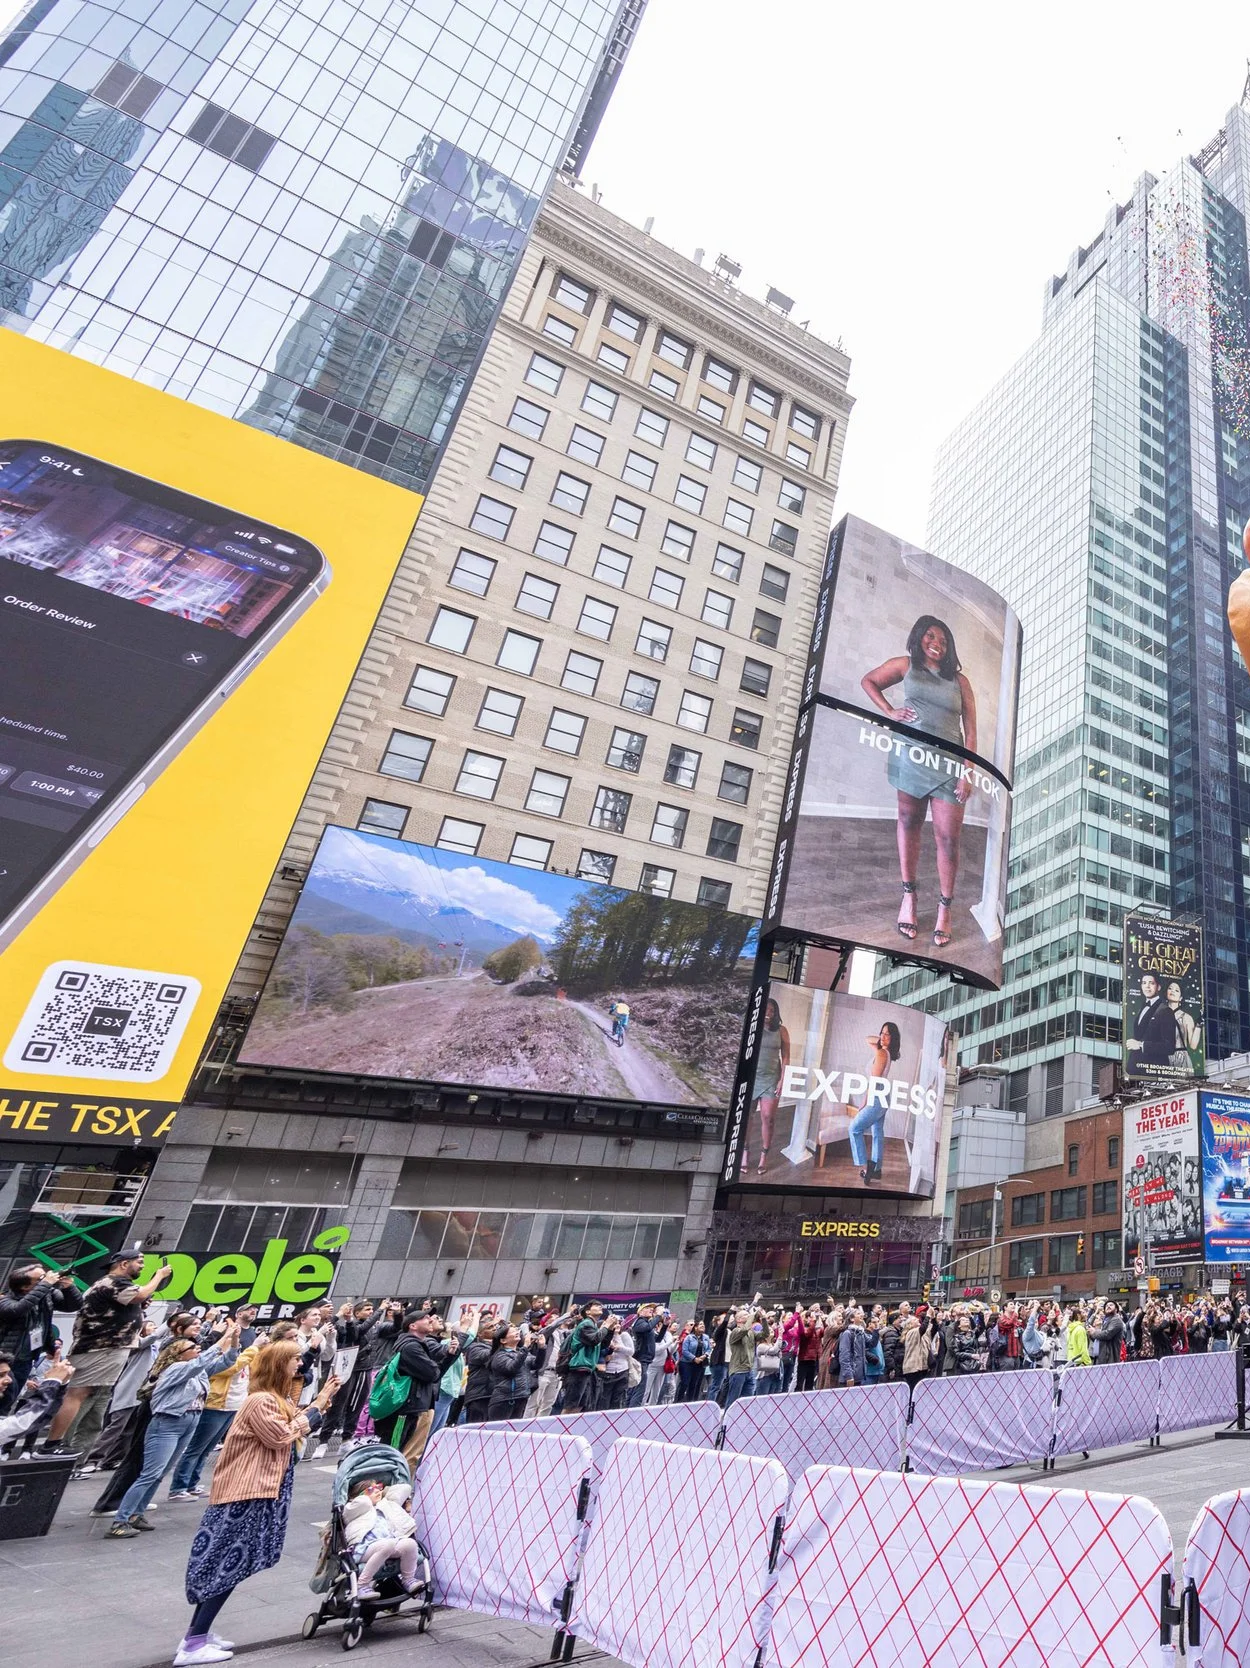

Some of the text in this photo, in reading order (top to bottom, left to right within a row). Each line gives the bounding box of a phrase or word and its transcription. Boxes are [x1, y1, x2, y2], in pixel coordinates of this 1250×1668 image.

[40, 455, 72, 471] 9:41
[225, 545, 277, 568] Creator Tips
[3, 595, 97, 629] Order Review
[812, 587, 829, 653] EXPRESS
[43, 729, 68, 741] time.
[66, 764, 104, 779] $40.00
[859, 727, 1000, 801] HOT ON TIKTOK
[30, 780, 55, 791] 1:00
[55, 786, 75, 797] PM
[784, 749, 802, 823] EXPRESS
[768, 839, 788, 920] EXPRESS
[1156, 925, 1190, 936] BEWITCHING
[1131, 939, 1198, 962] THE GREAT
[1138, 955, 1191, 976] GATSBY
[93, 1015, 124, 1029] TSX
[781, 1065, 938, 1120] EXPRESS
[70, 1103, 152, 1137] TSX
[1141, 1098, 1185, 1120] BEST OF
[725, 1082, 747, 1181] EXPRESS
[1136, 1112, 1190, 1134] THE YEAR!
[801, 1221, 880, 1238] EXPRESS
